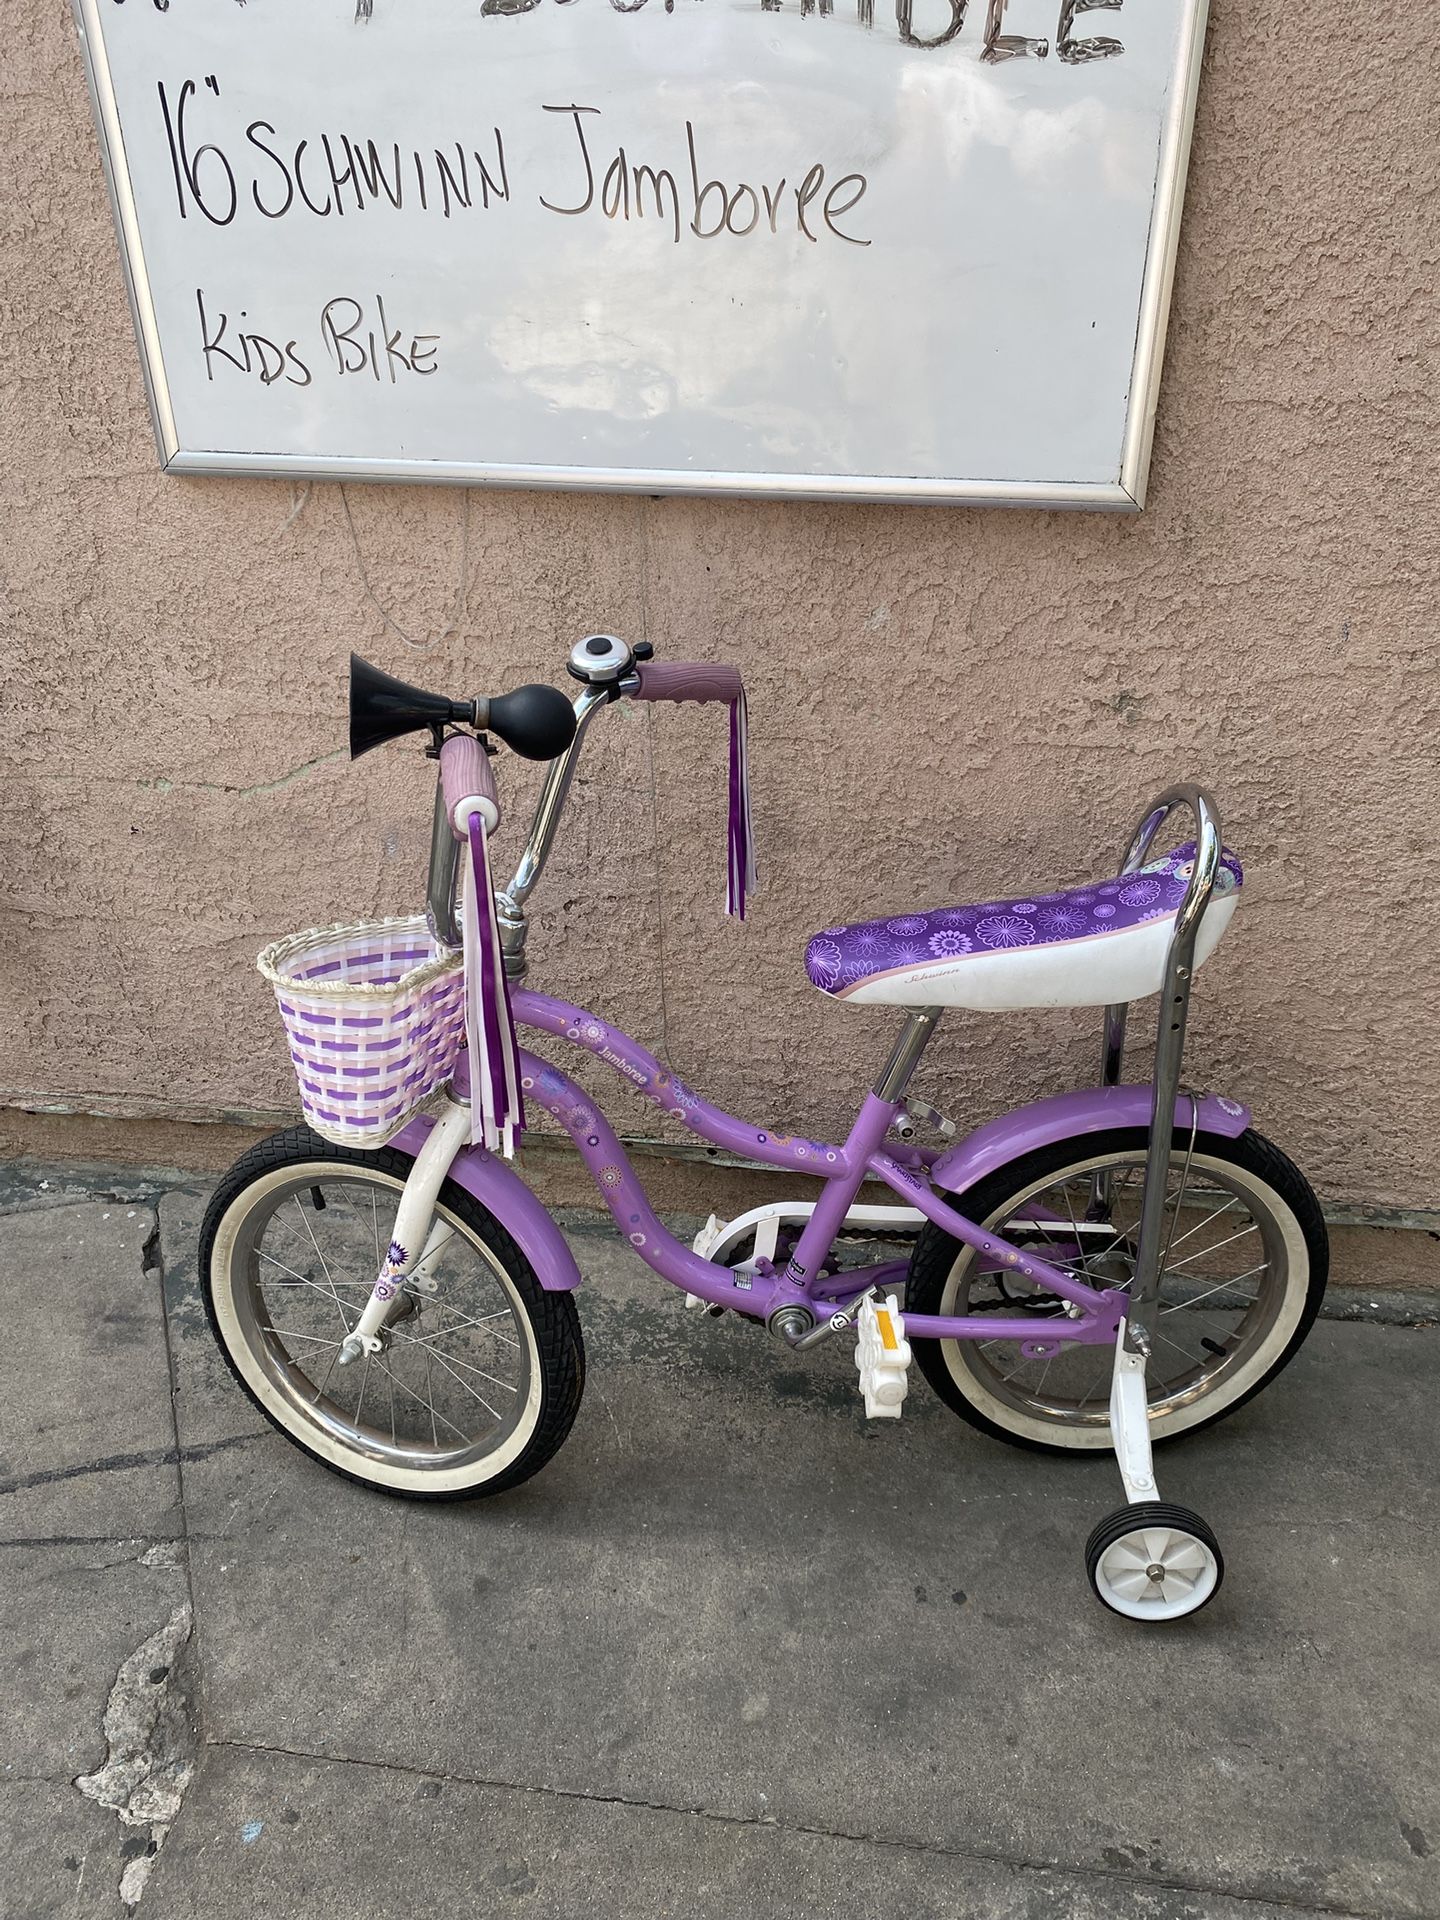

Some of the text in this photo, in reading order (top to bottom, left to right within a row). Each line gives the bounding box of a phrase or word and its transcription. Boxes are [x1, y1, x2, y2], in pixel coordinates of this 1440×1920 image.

[246, 121, 510, 219] SCHWINN
[539, 103, 873, 247] Jamboree
[598, 1046, 648, 1085] Jamboree
